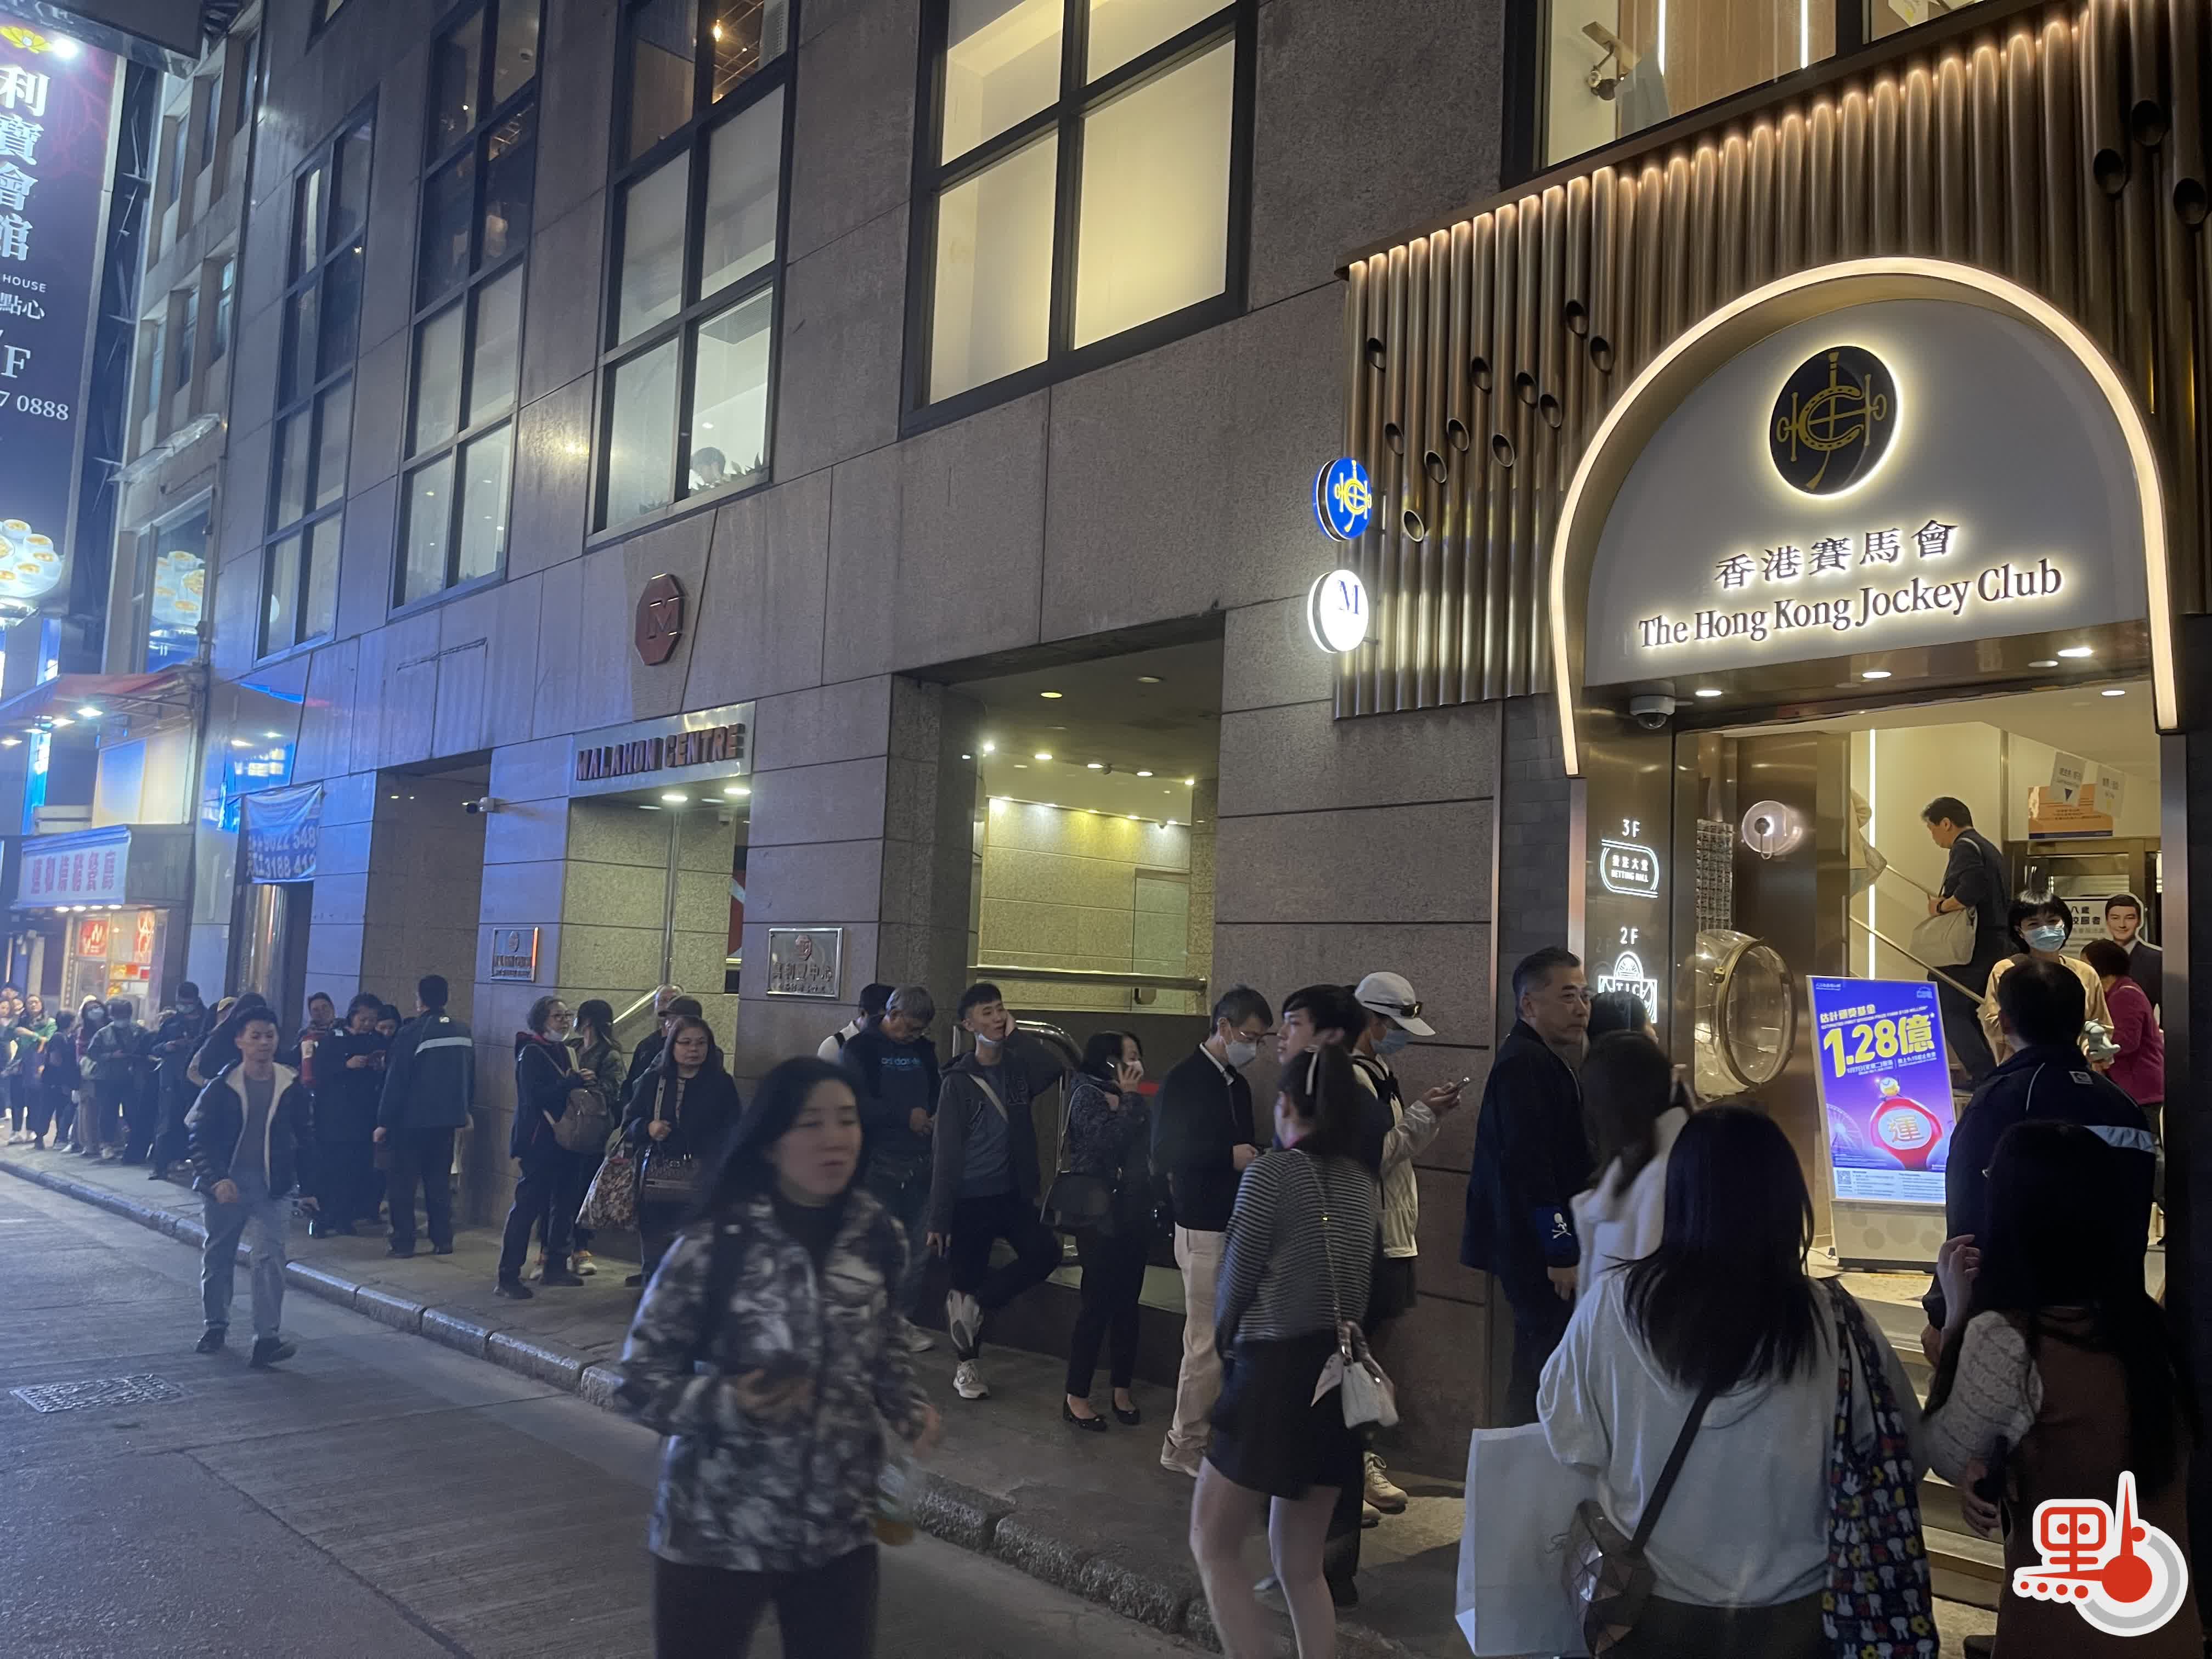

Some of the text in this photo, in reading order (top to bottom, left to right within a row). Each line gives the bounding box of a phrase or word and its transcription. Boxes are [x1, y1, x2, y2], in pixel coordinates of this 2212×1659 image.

[2, 274, 47, 293] HOUSE
[16, 395, 69, 421] 0888
[1715, 520, 1959, 589] 香港賽馬會
[1638, 557, 2063, 648] The Hong Kong Jockey Club
[576, 724, 745, 781] MALAHON CENTRE
[1622, 819, 1640, 838] 3F
[1620, 927, 1639, 945] 2F
[1887, 1114, 1925, 1143] 運
